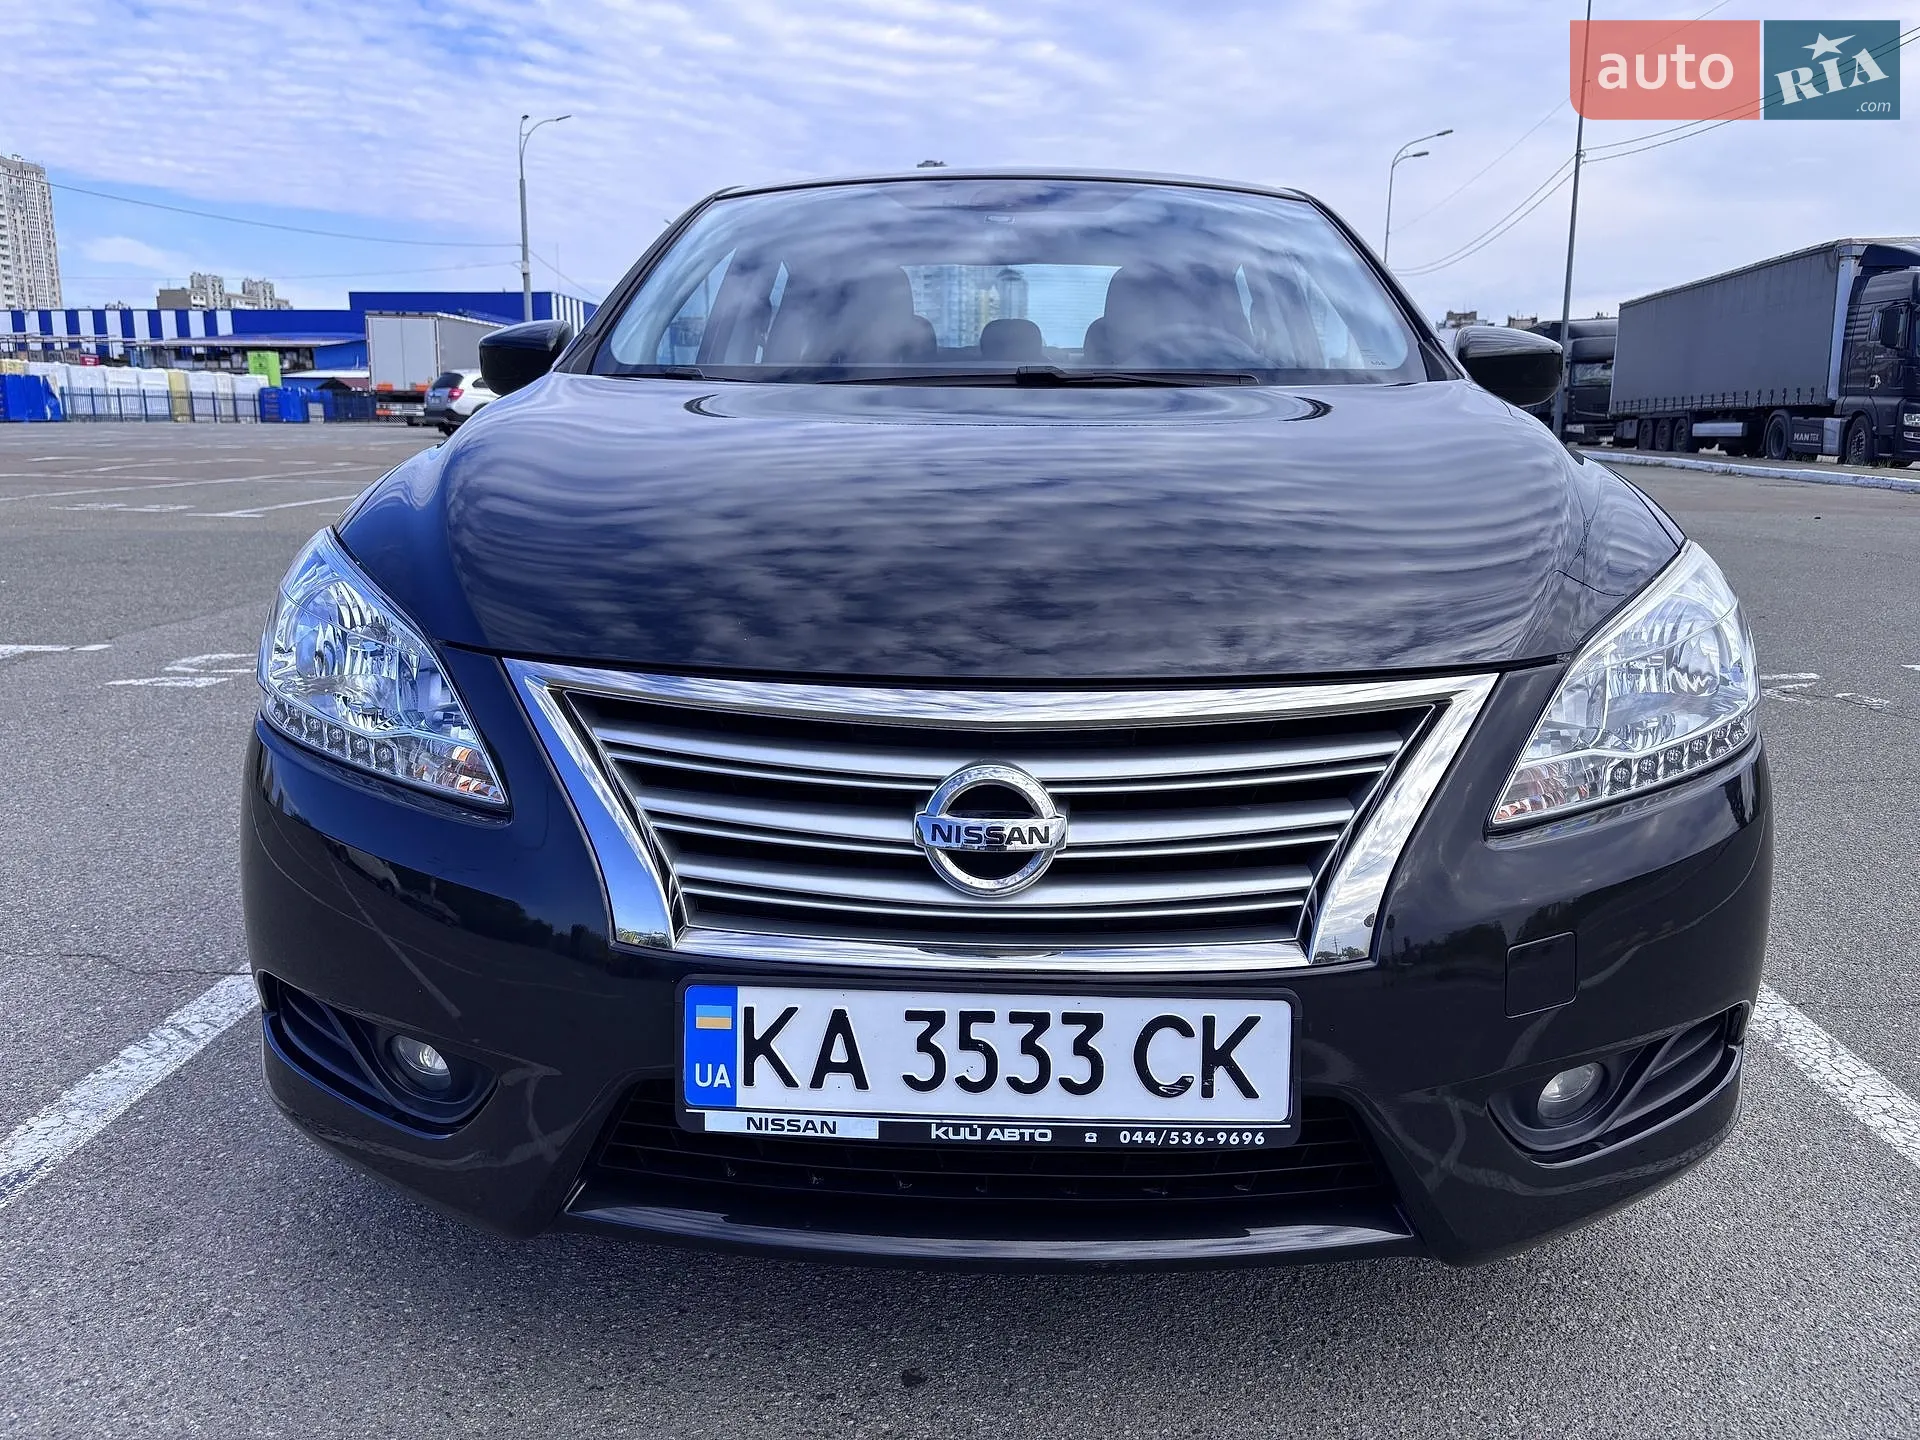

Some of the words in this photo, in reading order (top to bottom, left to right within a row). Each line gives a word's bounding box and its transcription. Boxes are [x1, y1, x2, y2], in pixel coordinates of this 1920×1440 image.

[931, 823, 1050, 846] NISSAN
[743, 1006, 870, 1091] KA
[901, 1009, 1105, 1096] 3533
[1132, 1014, 1262, 1100] CK
[694, 1063, 732, 1089] UA
[746, 1116, 838, 1135] NISSAN
[1119, 1130, 1266, 1146] 044/536-9696
